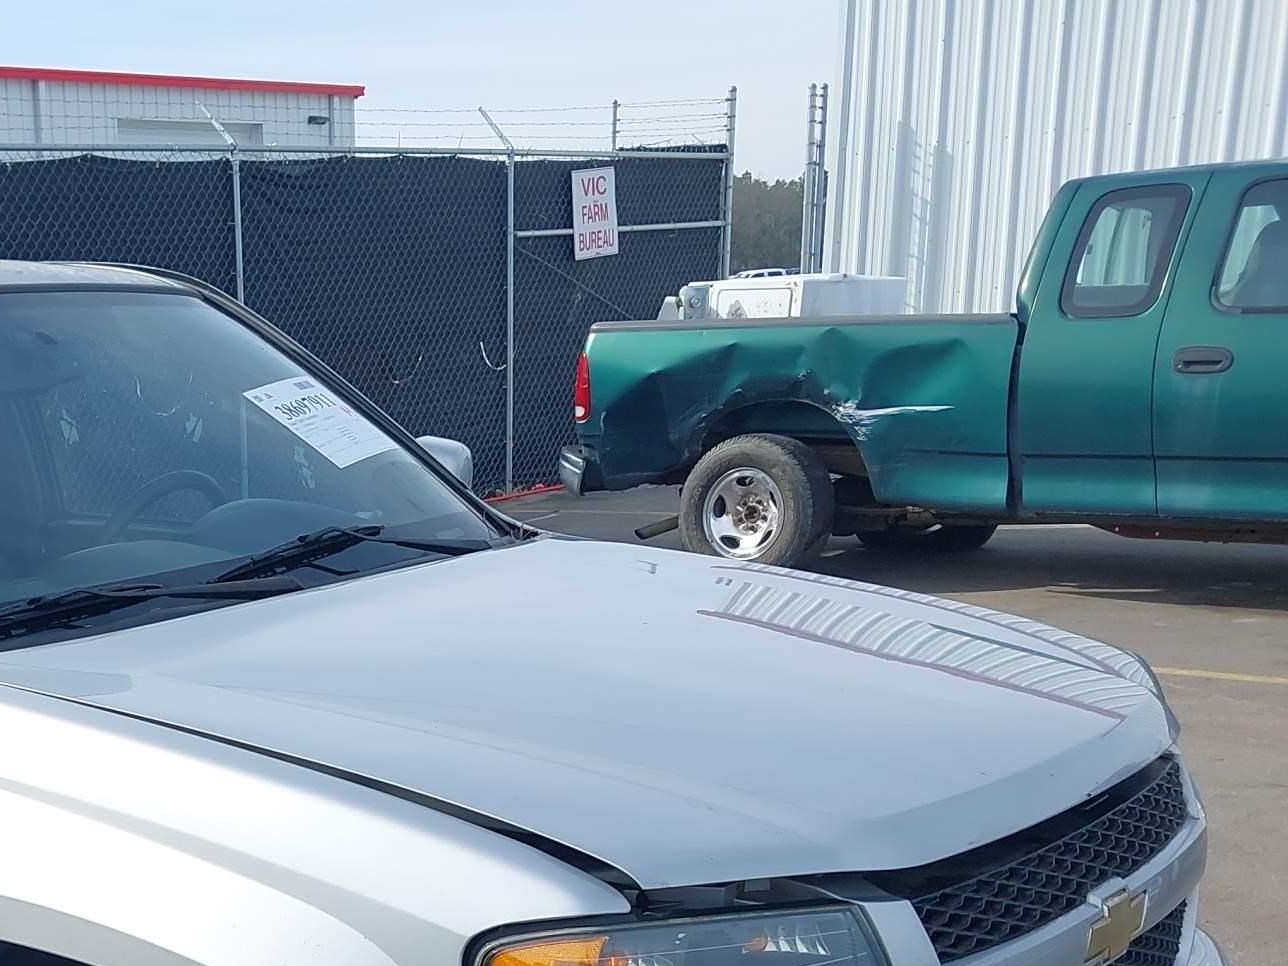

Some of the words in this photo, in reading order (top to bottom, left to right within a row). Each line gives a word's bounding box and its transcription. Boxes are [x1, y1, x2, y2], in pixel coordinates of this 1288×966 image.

[581, 175, 607, 197] VIC
[581, 202, 609, 225] FARM
[578, 228, 615, 252] BUREAU
[274, 392, 337, 421] 38697911
